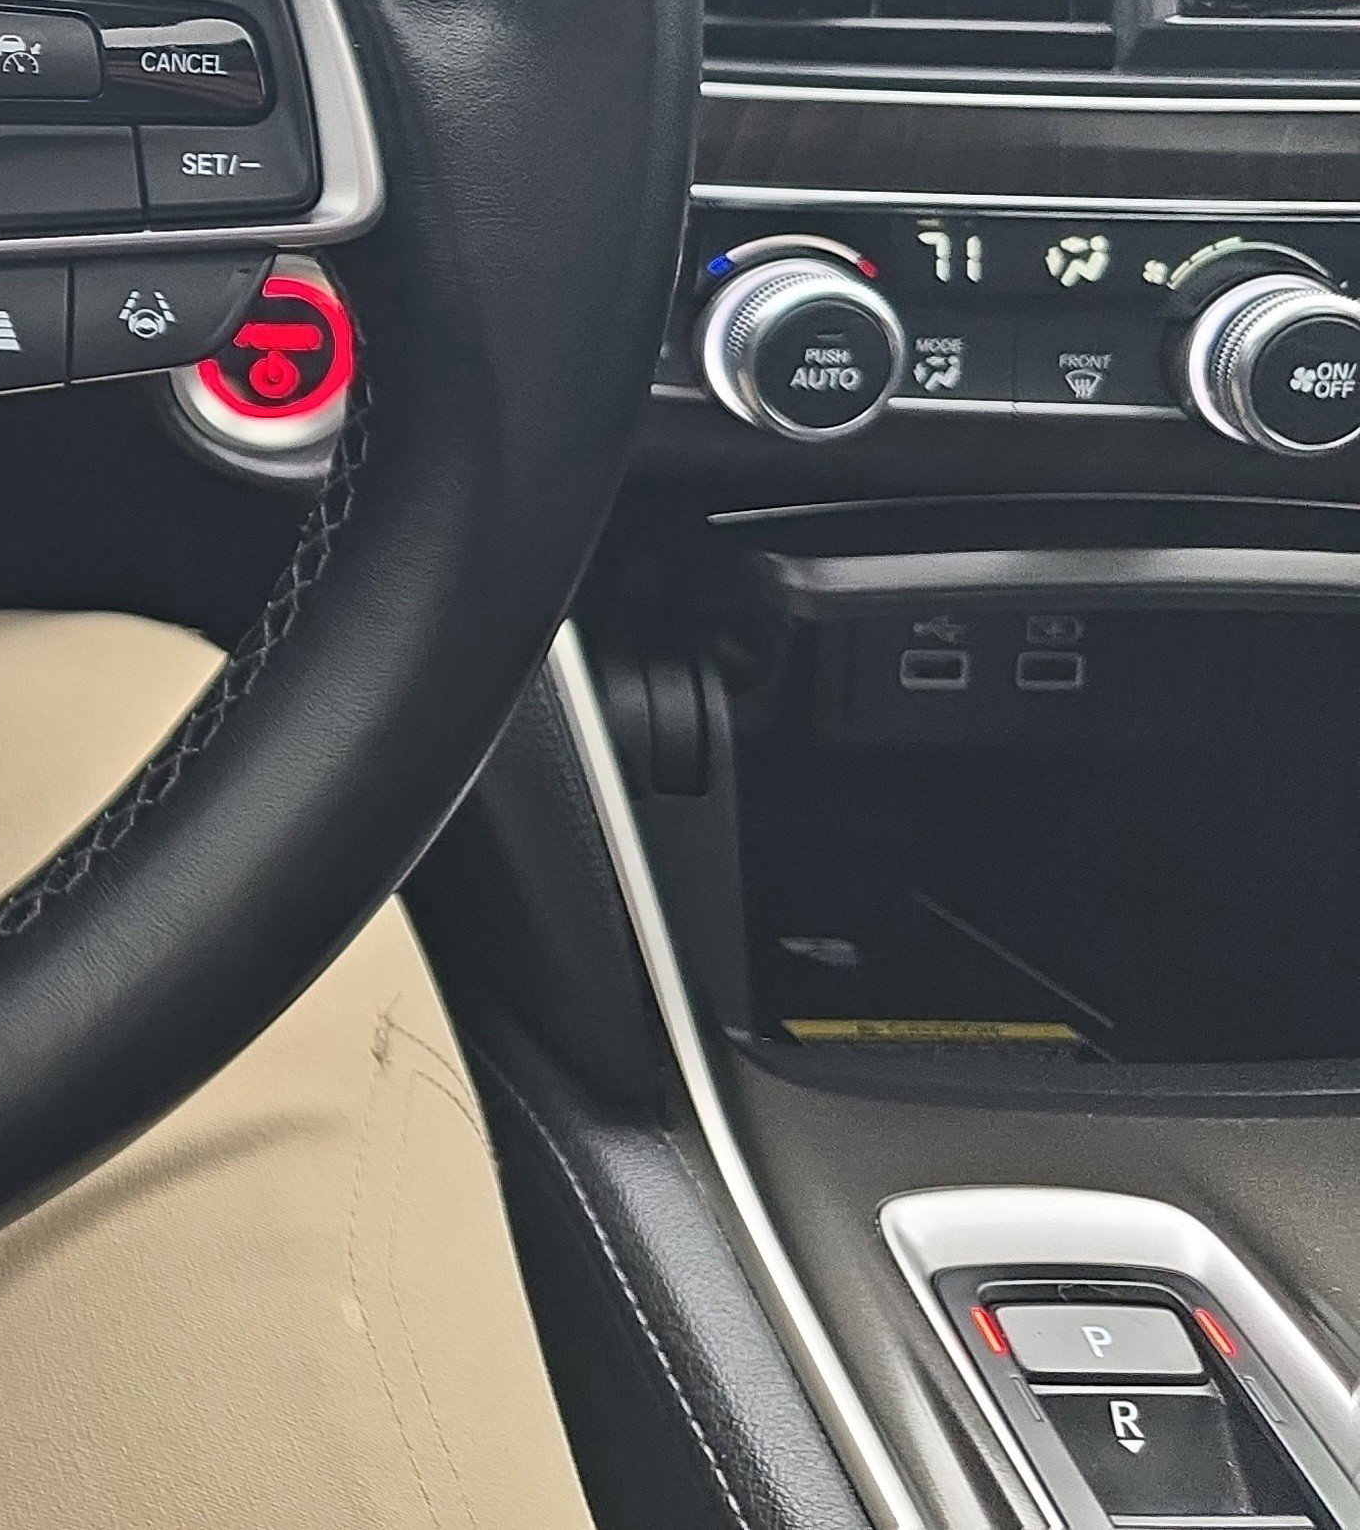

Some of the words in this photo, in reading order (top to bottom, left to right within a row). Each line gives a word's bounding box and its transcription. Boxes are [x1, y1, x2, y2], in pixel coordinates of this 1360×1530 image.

[140, 51, 228, 75] CANCEL
[181, 153, 262, 176] SET/-
[917, 231, 982, 283] 71
[804, 348, 851, 364] PUSH
[915, 338, 964, 353] MODE
[1058, 354, 1112, 369] FRONT
[1316, 361, 1358, 380] ON/
[790, 367, 861, 391] AUTO
[1314, 380, 1356, 399] OFF
[1082, 1325, 1113, 1358] P
[1110, 1401, 1144, 1438] R
